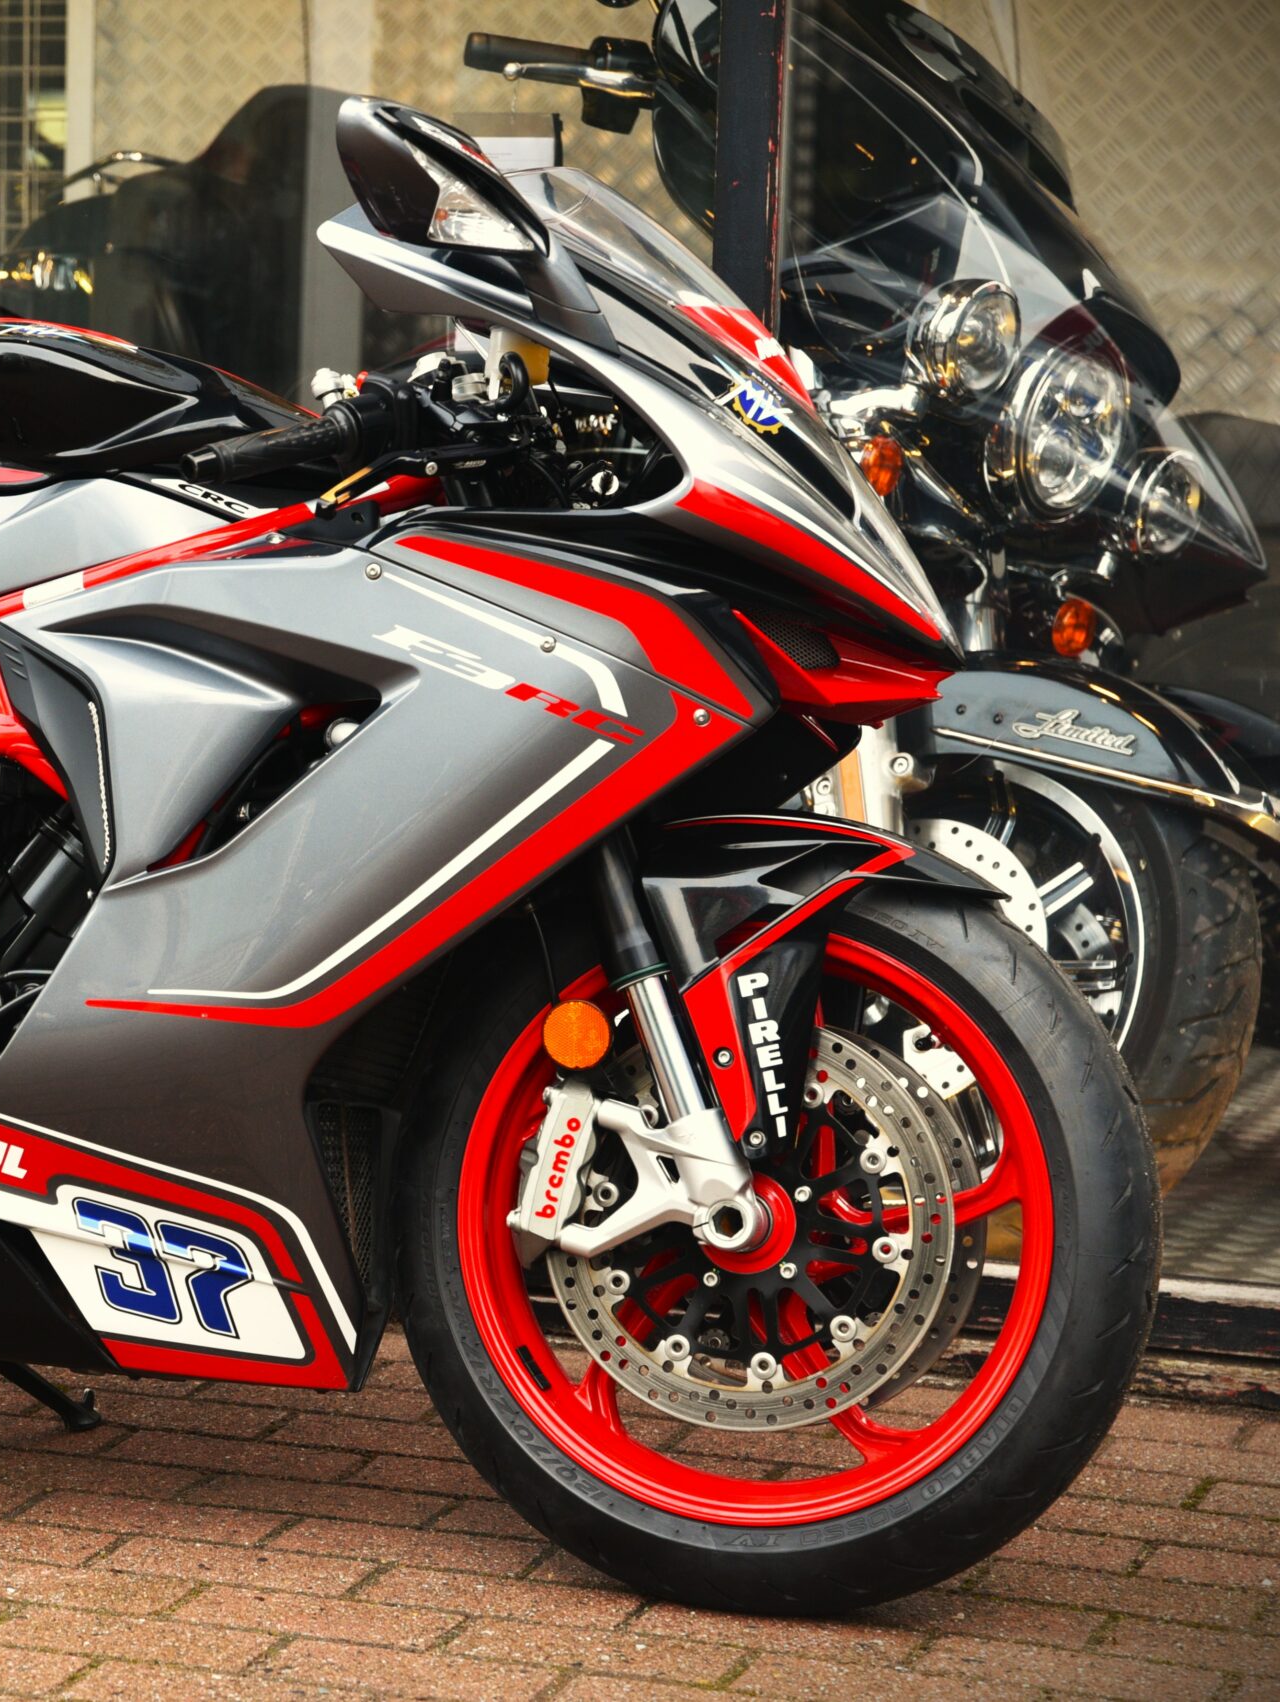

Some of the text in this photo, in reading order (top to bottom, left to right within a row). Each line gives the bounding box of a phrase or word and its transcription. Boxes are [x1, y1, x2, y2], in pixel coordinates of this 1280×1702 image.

[178, 483, 250, 515] CRC
[372, 624, 645, 745] F3 RC
[1012, 708, 1136, 756] Limited
[737, 972, 789, 1138] PIRELLI
[535, 1117, 582, 1219] brembo
[71, 1197, 255, 1340] 37
[516, 1423, 610, 1501] 120/70
[920, 1395, 1028, 1502] DIABLO
[799, 1495, 914, 1547] ROSSO
